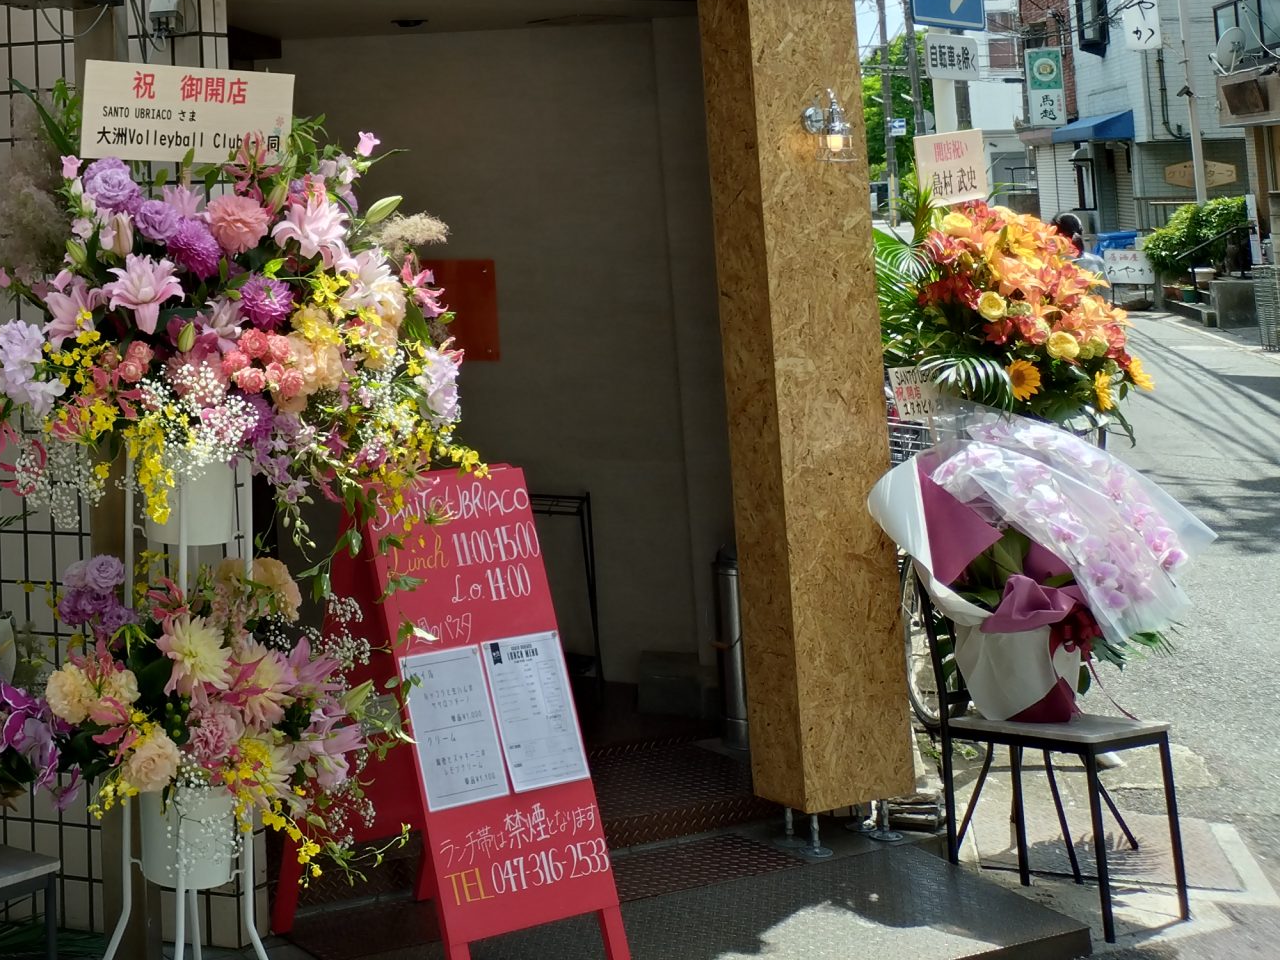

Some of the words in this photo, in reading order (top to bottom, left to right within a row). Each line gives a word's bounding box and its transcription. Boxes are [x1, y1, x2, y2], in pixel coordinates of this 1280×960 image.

[930, 43, 976, 72] 自転車を除く
[132, 70, 156, 100] 祝
[180, 74, 249, 105] 御開店
[102, 106, 130, 119] SANTO
[135, 108, 172, 120] UBRIACO
[178, 110, 197, 122] さま
[96, 126, 203, 149] 大洲Volleyball
[213, 134, 242, 149] Club
[933, 140, 968, 163] 開店祝い
[932, 170, 953, 197] 島村
[957, 166, 978, 193] 武史
[387, 535, 451, 579] Lunch
[485, 563, 531, 602] 14:00
[439, 802, 597, 869] ランチ帯は禁煙となります
[443, 867, 495, 906] TEL
[490, 837, 610, 895] 047-316-2533
